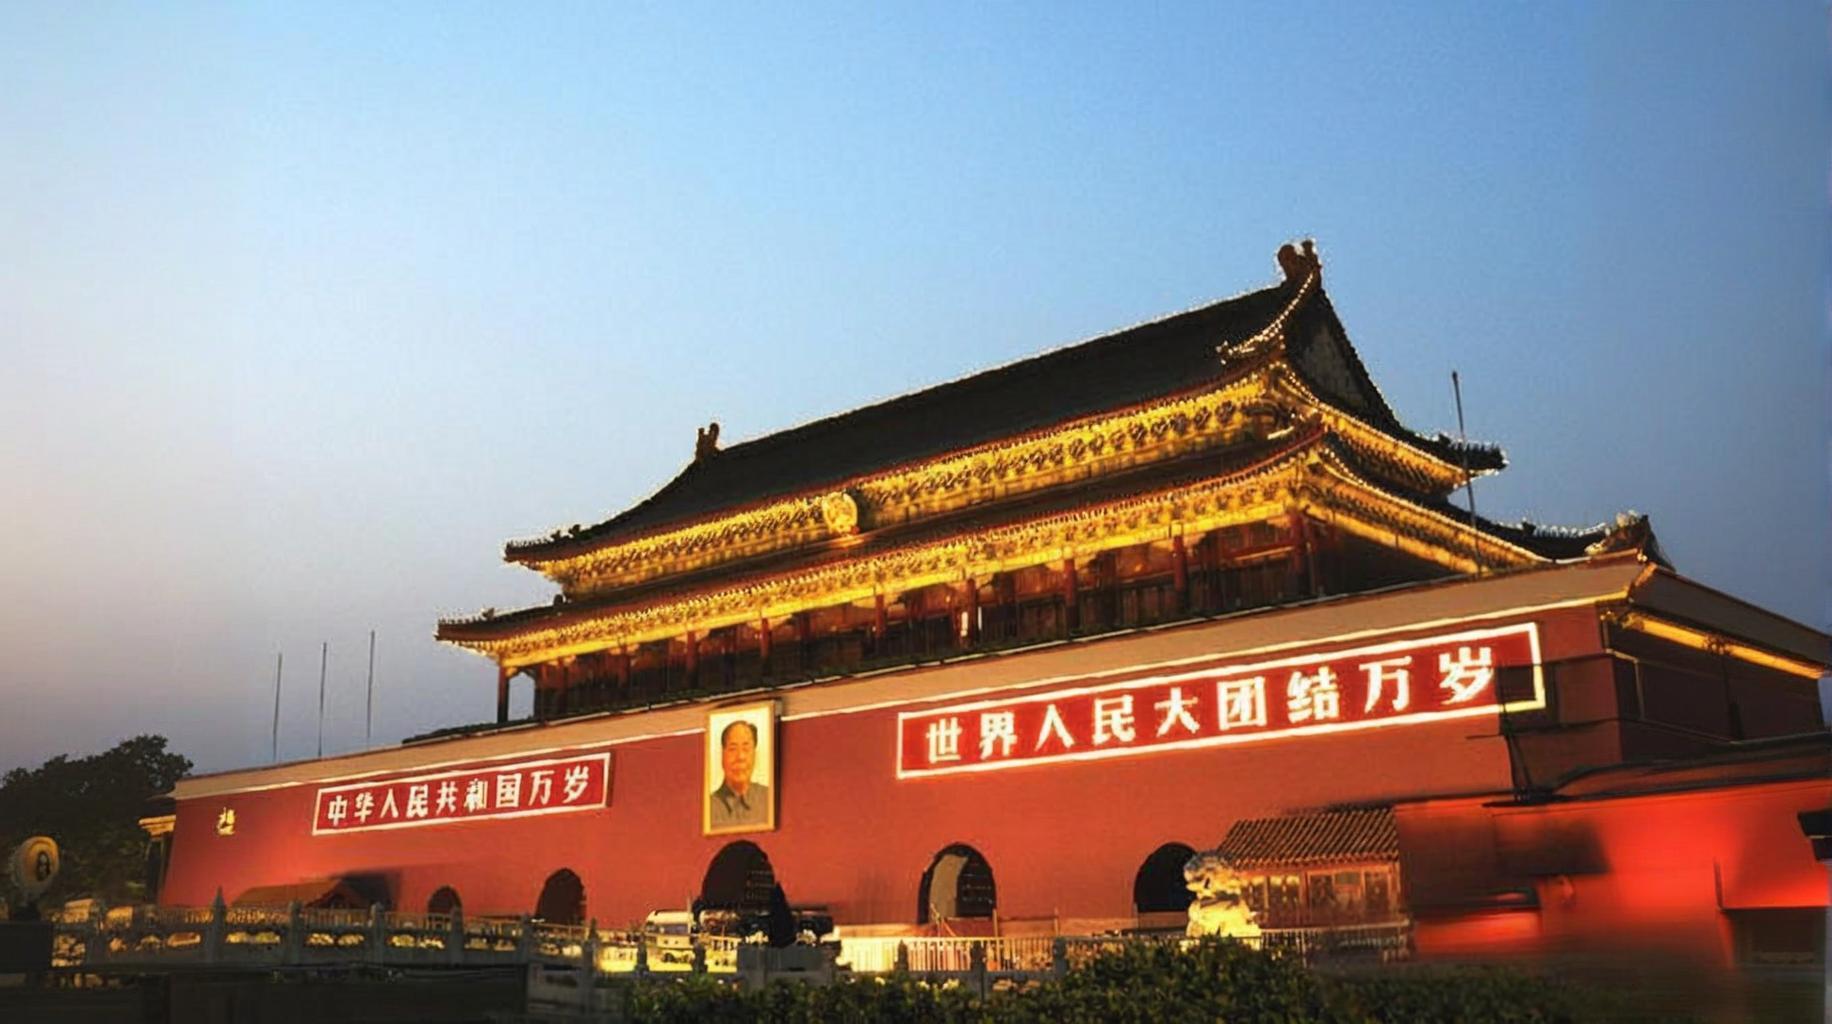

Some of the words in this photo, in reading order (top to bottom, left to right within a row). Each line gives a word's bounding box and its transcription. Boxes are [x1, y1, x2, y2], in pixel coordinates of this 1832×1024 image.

[926, 647, 1494, 763] 世界人民大团结万岁
[327, 765, 589, 826] 中华人民共和国万岁
